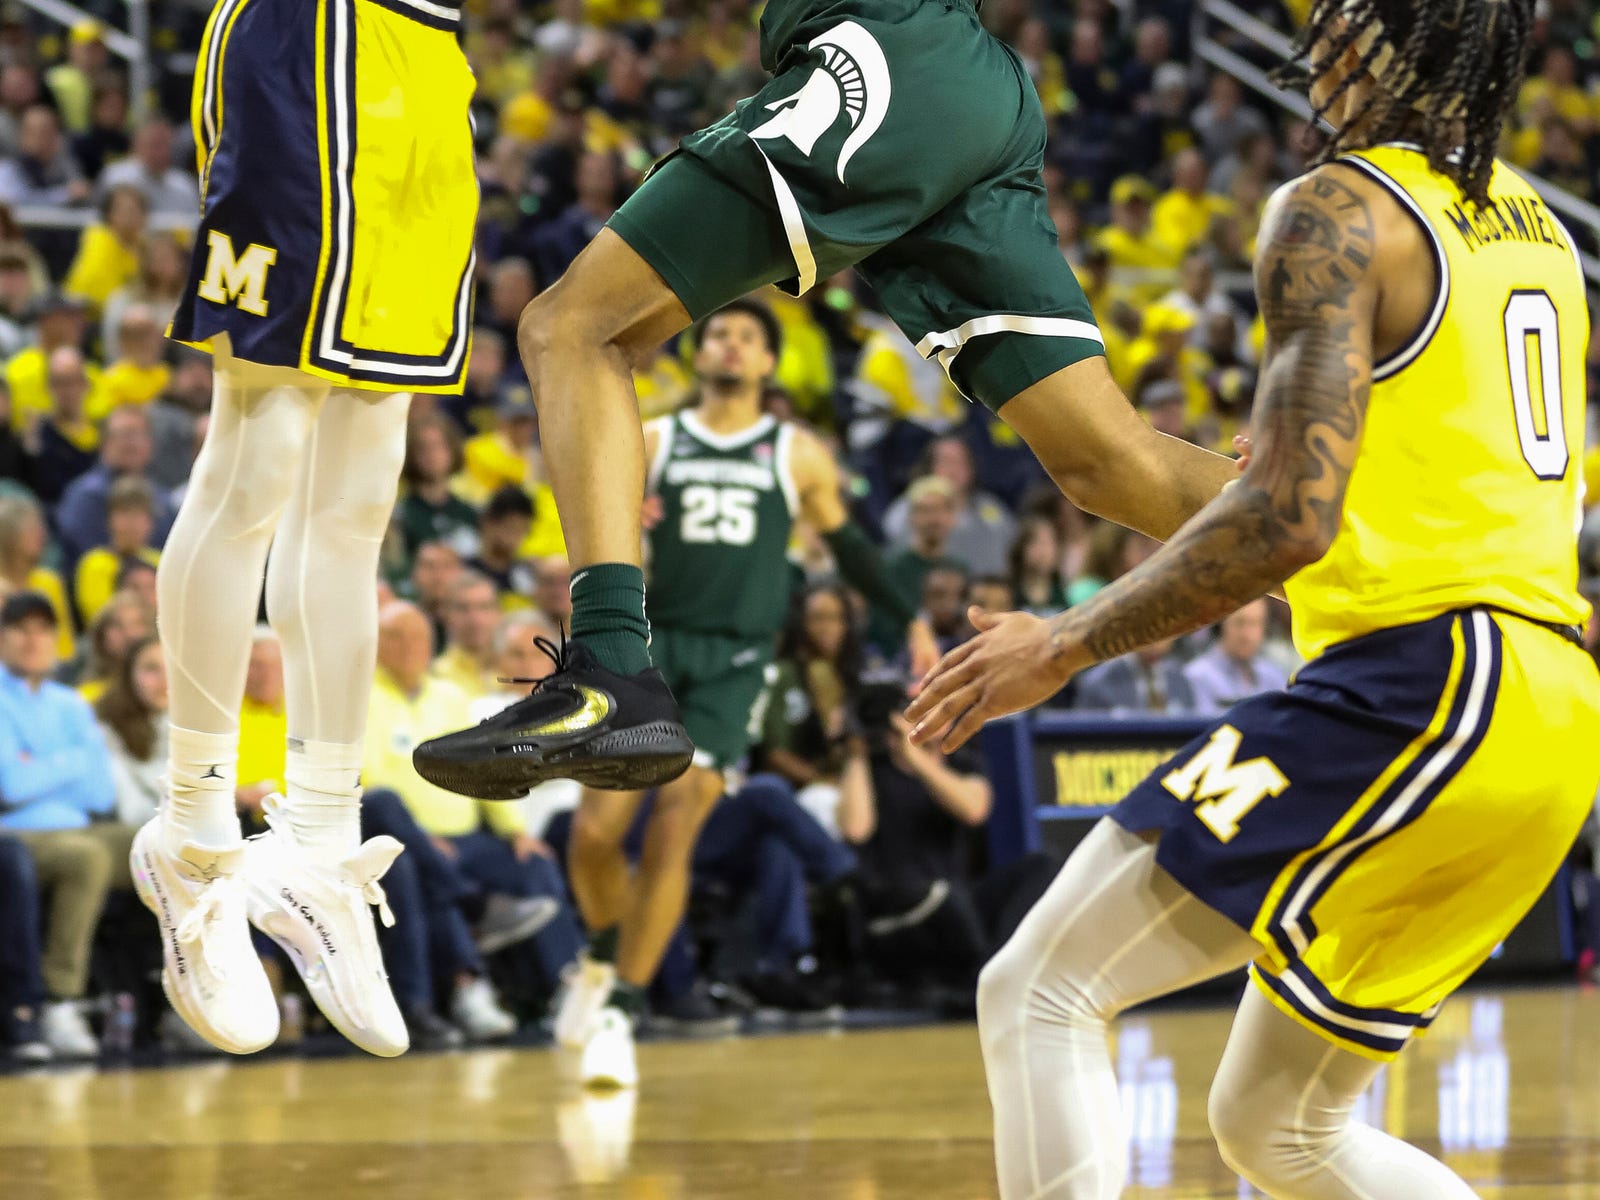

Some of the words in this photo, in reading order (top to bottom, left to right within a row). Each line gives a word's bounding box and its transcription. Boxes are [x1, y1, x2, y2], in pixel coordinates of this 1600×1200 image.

[197, 229, 278, 317] M
[1503, 288, 1570, 481] 0
[680, 485, 758, 546] 25
[1160, 722, 1292, 845] M
